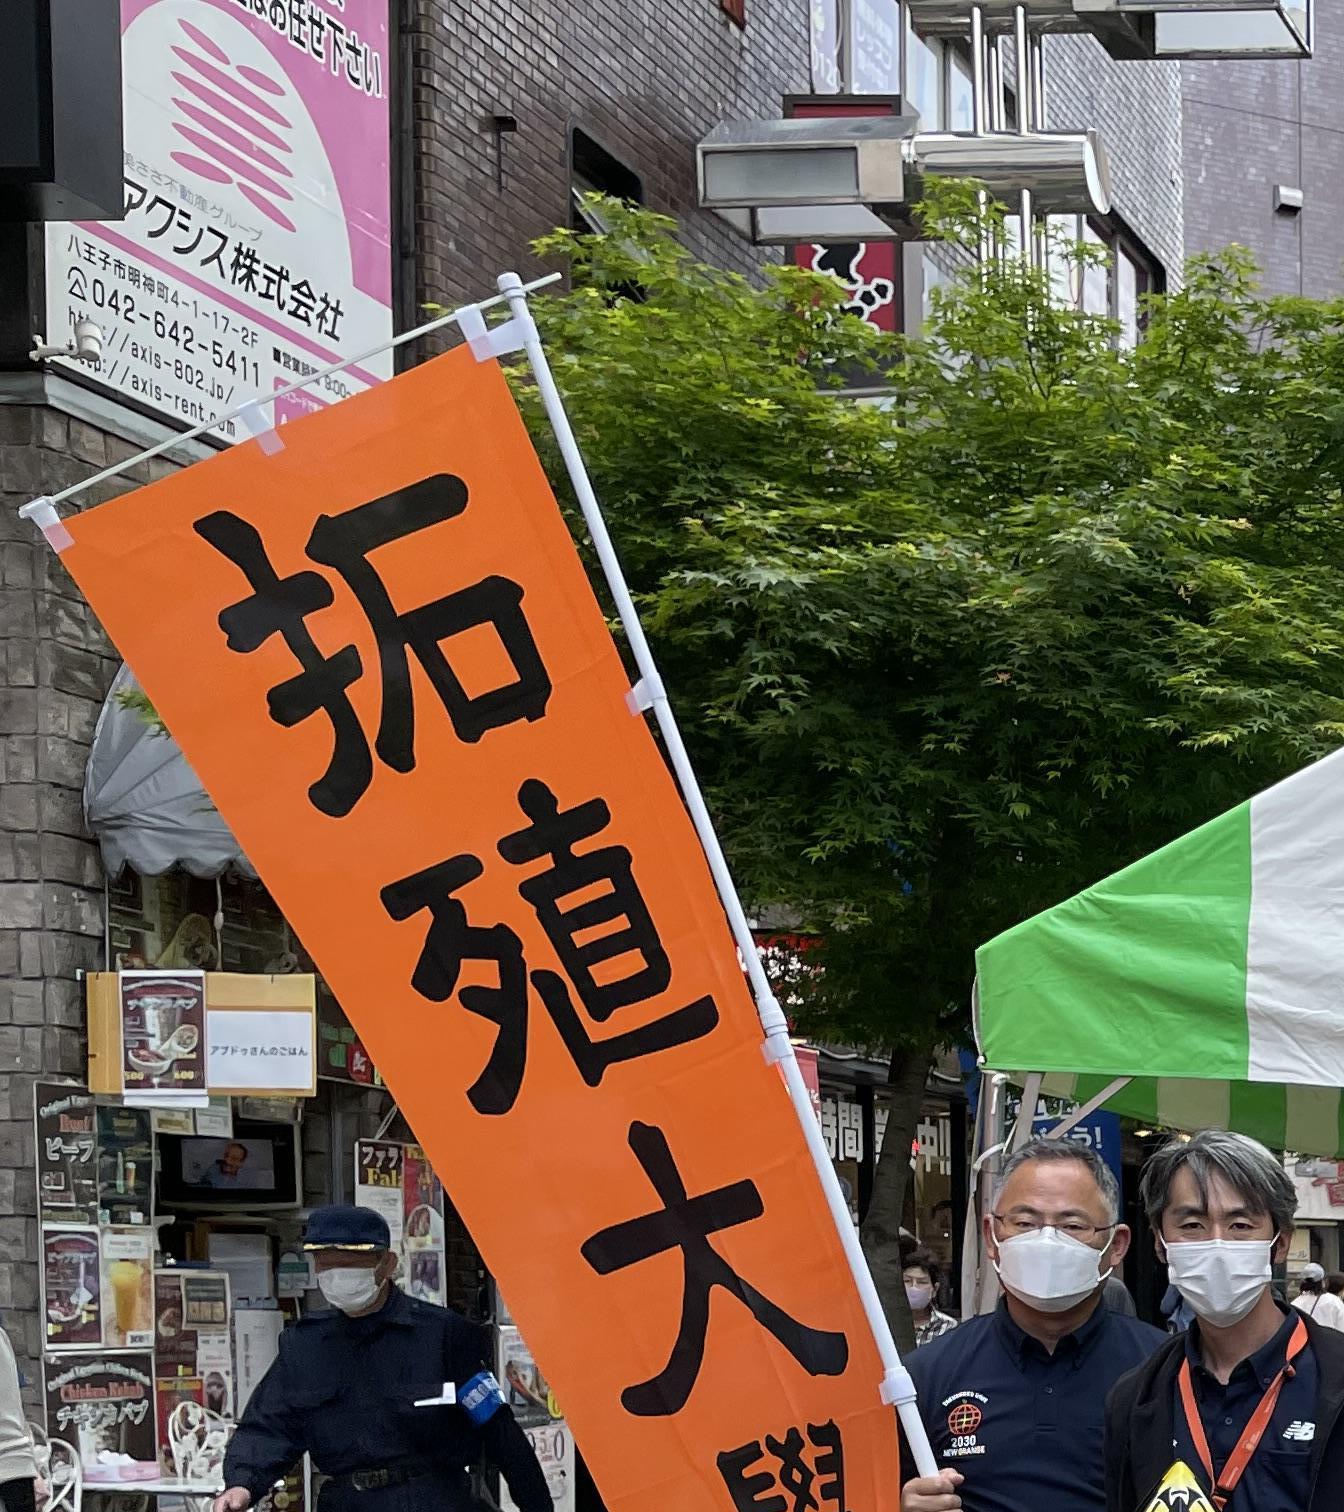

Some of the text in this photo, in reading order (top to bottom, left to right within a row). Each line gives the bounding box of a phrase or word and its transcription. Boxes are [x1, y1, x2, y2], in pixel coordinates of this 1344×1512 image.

[123, 177, 344, 342] アクシス株式会社
[92, 279, 260, 388] 042-642-5411
[951, 1434, 977, 1448] 2030
